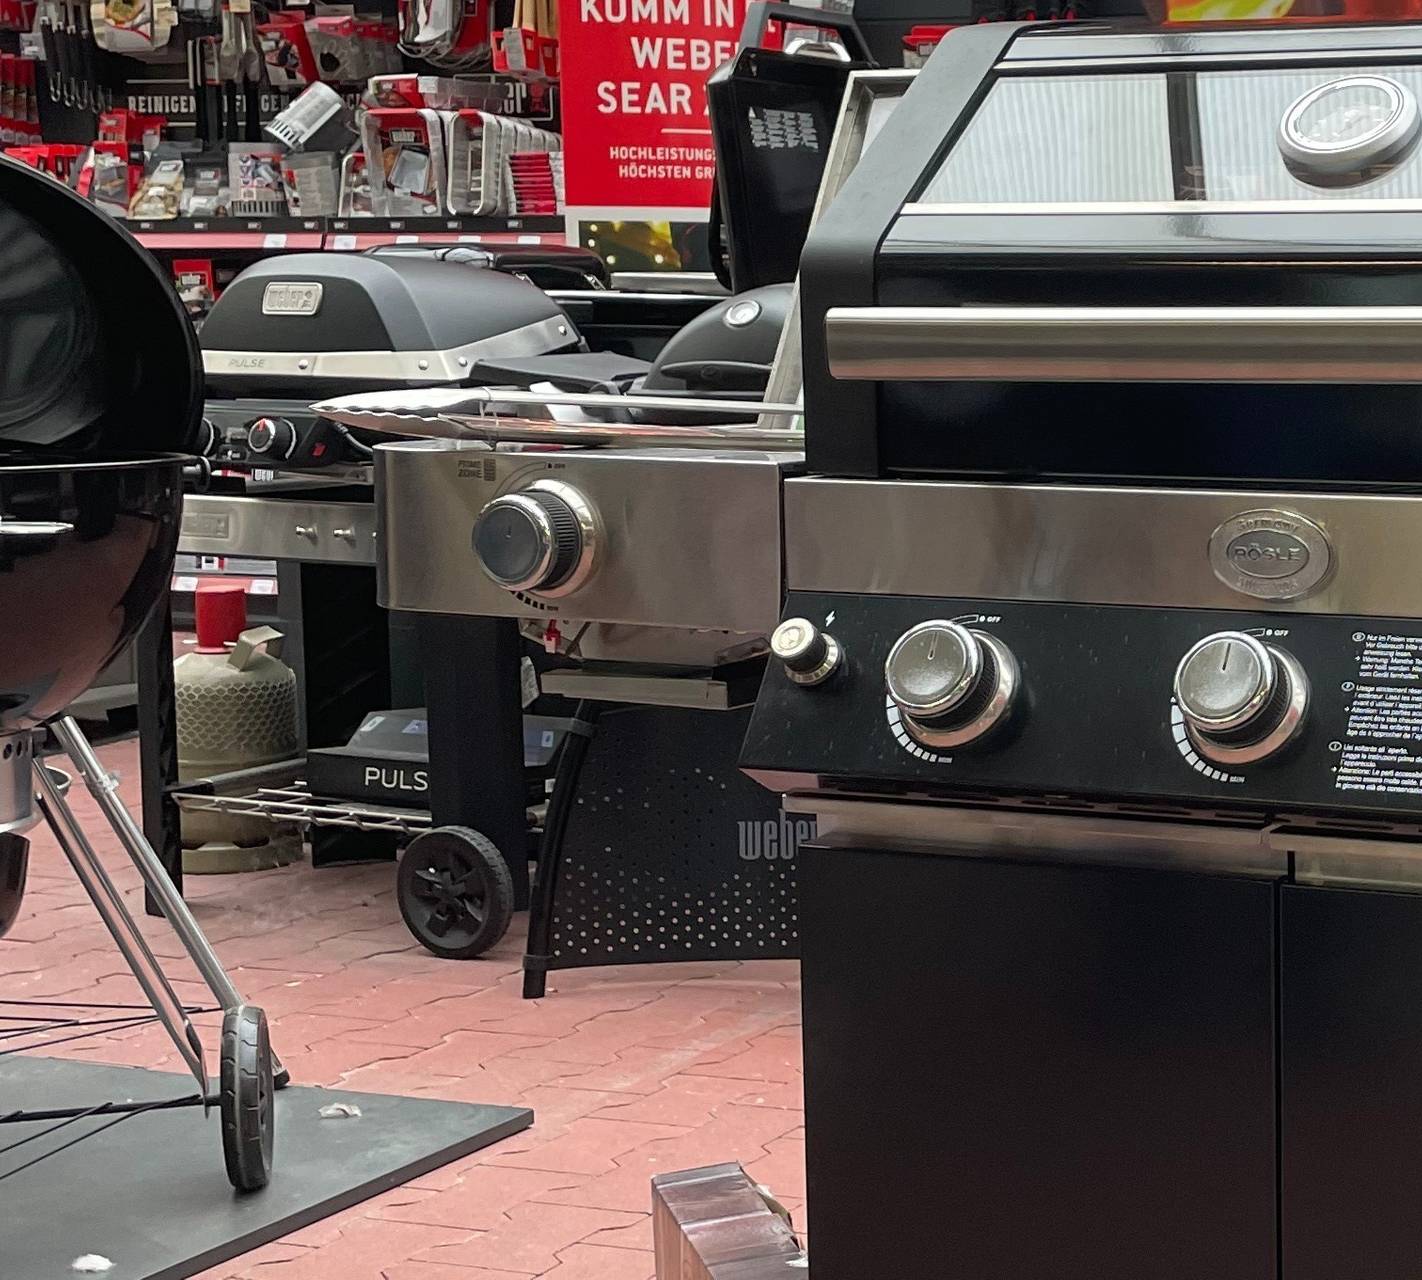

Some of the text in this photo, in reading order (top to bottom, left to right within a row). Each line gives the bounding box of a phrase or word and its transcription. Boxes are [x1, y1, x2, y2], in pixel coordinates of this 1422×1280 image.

[704, 0, 735, 28] IN
[631, 36, 740, 71] WEBE
[597, 81, 693, 115] SEAR
[618, 162, 691, 179] HÖCHSTEN
[1233, 543, 1301, 561] RÖSLE
